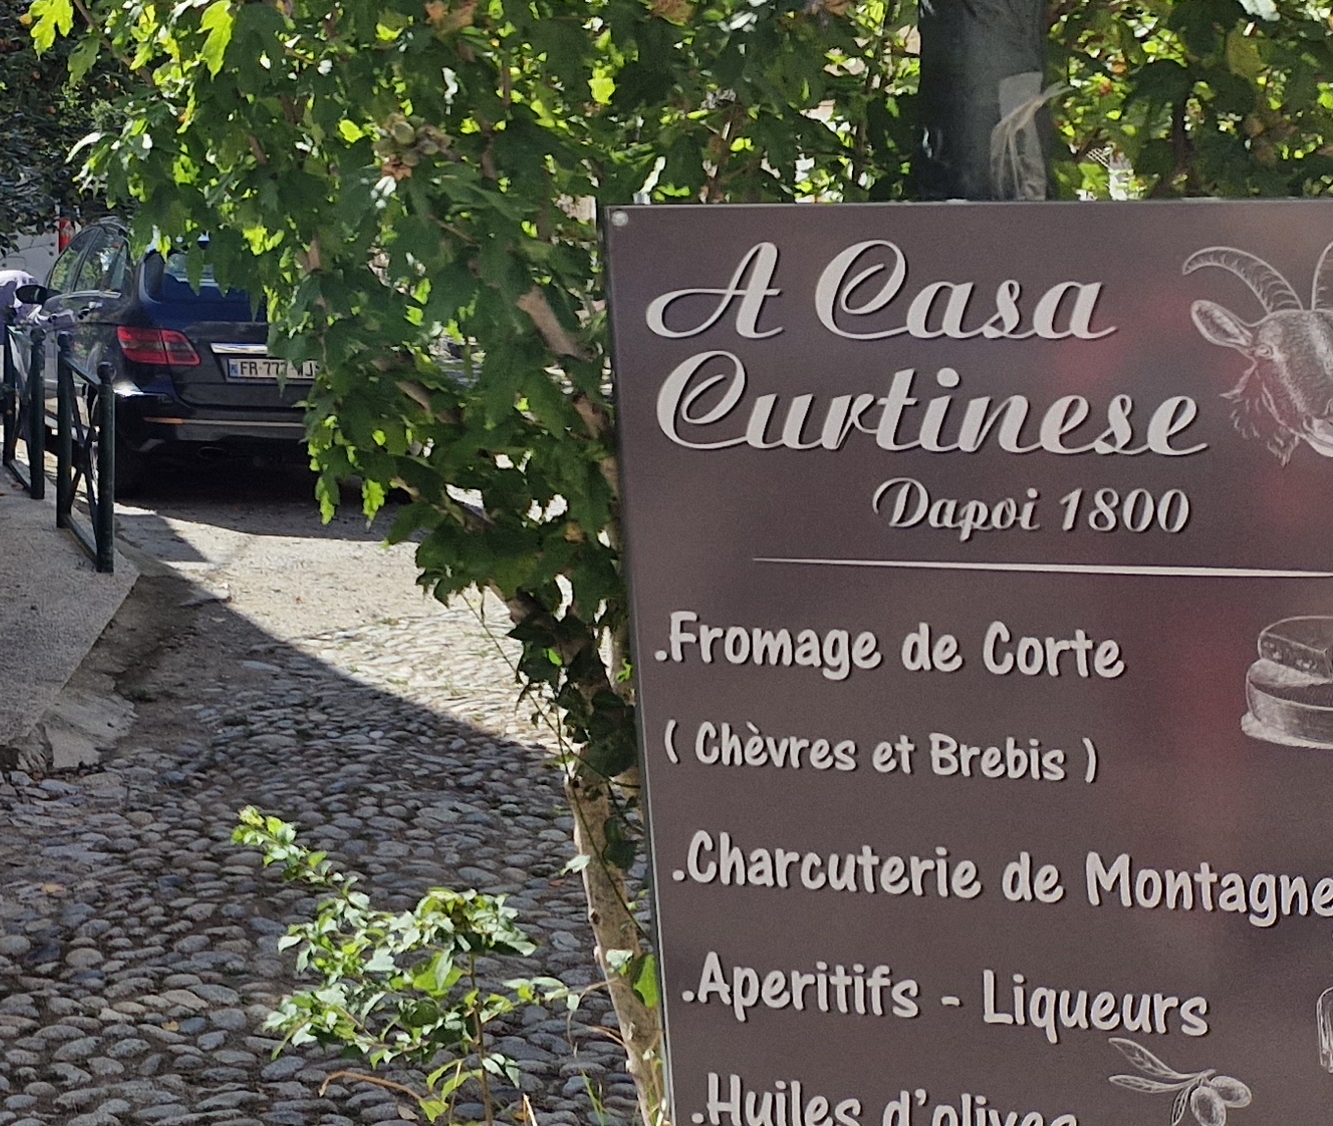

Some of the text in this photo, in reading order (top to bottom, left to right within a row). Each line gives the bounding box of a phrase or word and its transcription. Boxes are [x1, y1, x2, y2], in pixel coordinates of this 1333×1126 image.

[645, 239, 1118, 340] A Casa
[656, 350, 1209, 457] Curtinese
[872, 477, 1190, 542] Dapoi 1800
[901, 622, 963, 672] de
[983, 621, 1125, 678] Corte
[695, 720, 857, 771] Chèvres
[872, 734, 915, 774] et
[930, 732, 1066, 780] Brebis
[1002, 851, 1064, 904] de
[1085, 852, 1333, 928] Montagne
[983, 969, 1209, 1042] Liqueurs
